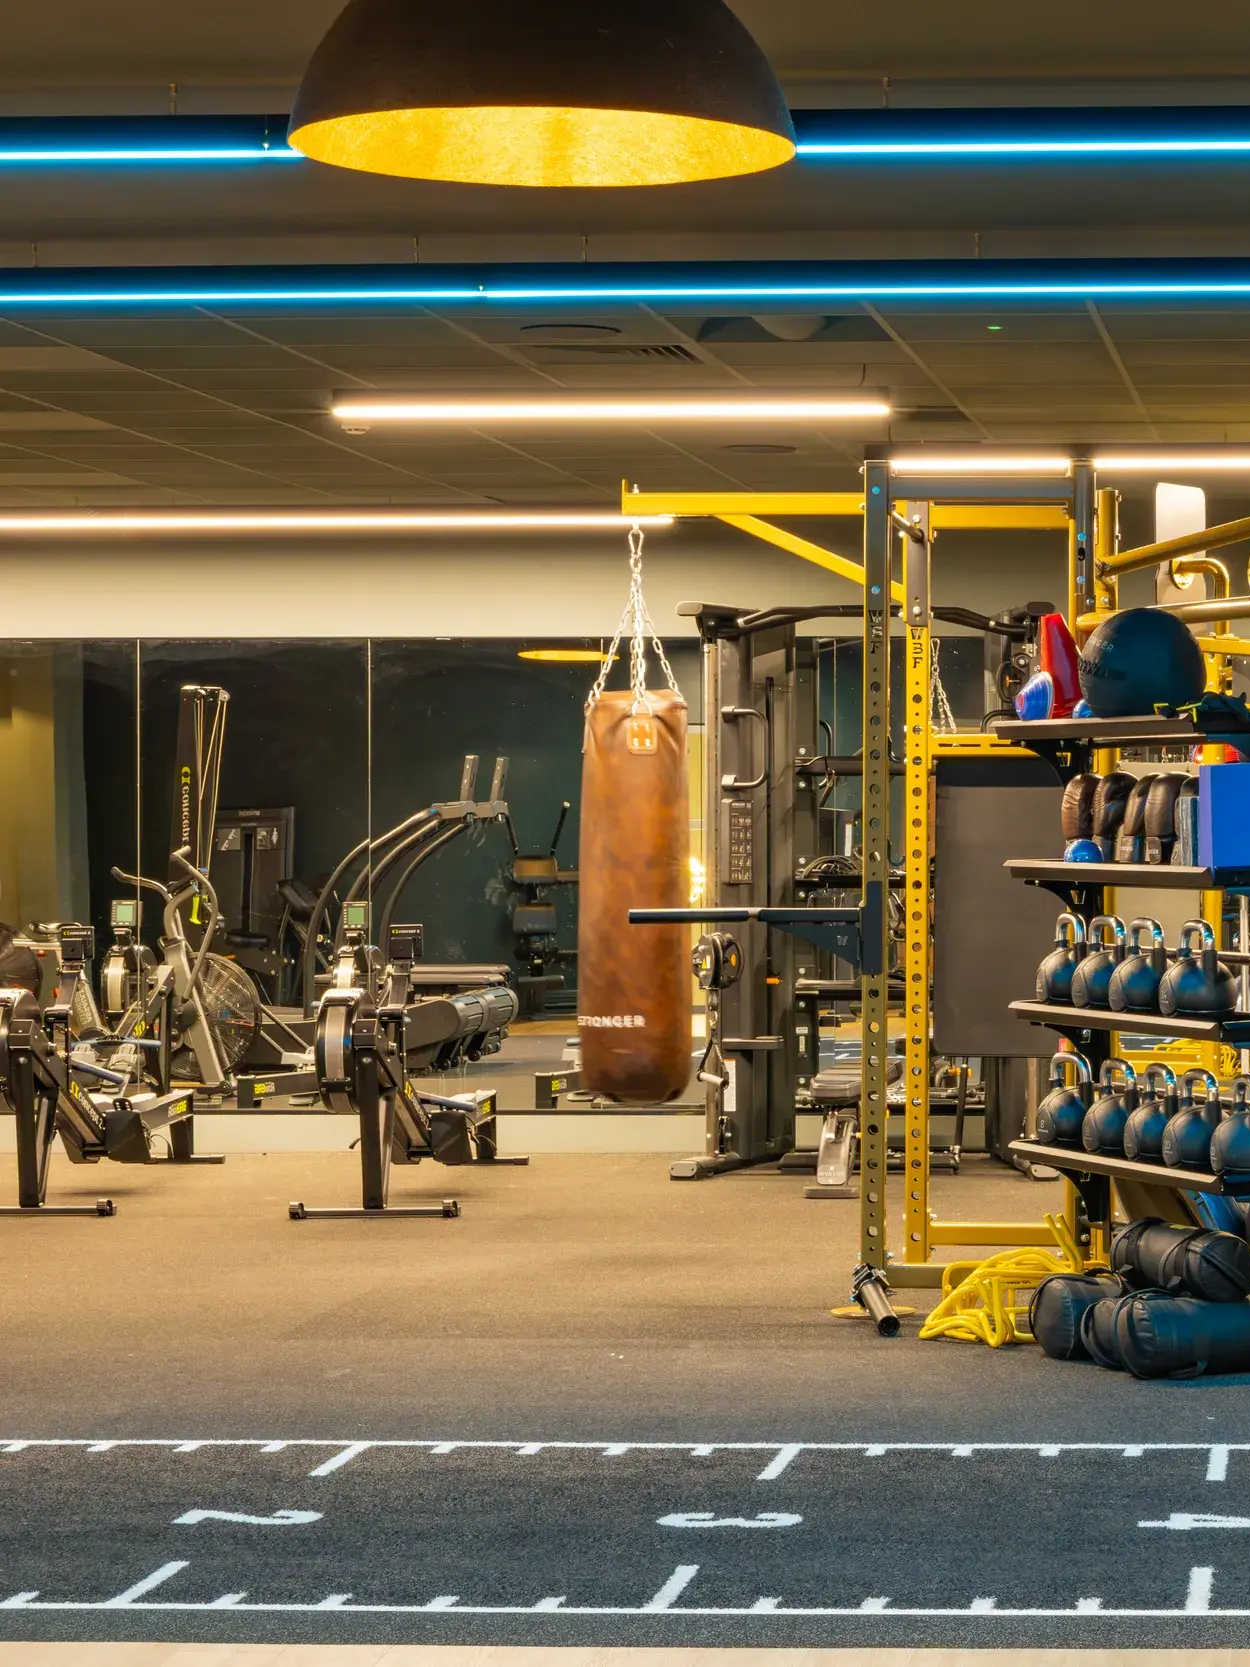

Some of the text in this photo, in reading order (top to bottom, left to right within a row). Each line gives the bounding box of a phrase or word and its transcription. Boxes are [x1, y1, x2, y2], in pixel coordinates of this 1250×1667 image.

[1040, 1119, 1045, 1129] 8
[171, 1507, 324, 1526] 2
[655, 1511, 804, 1529] 3
